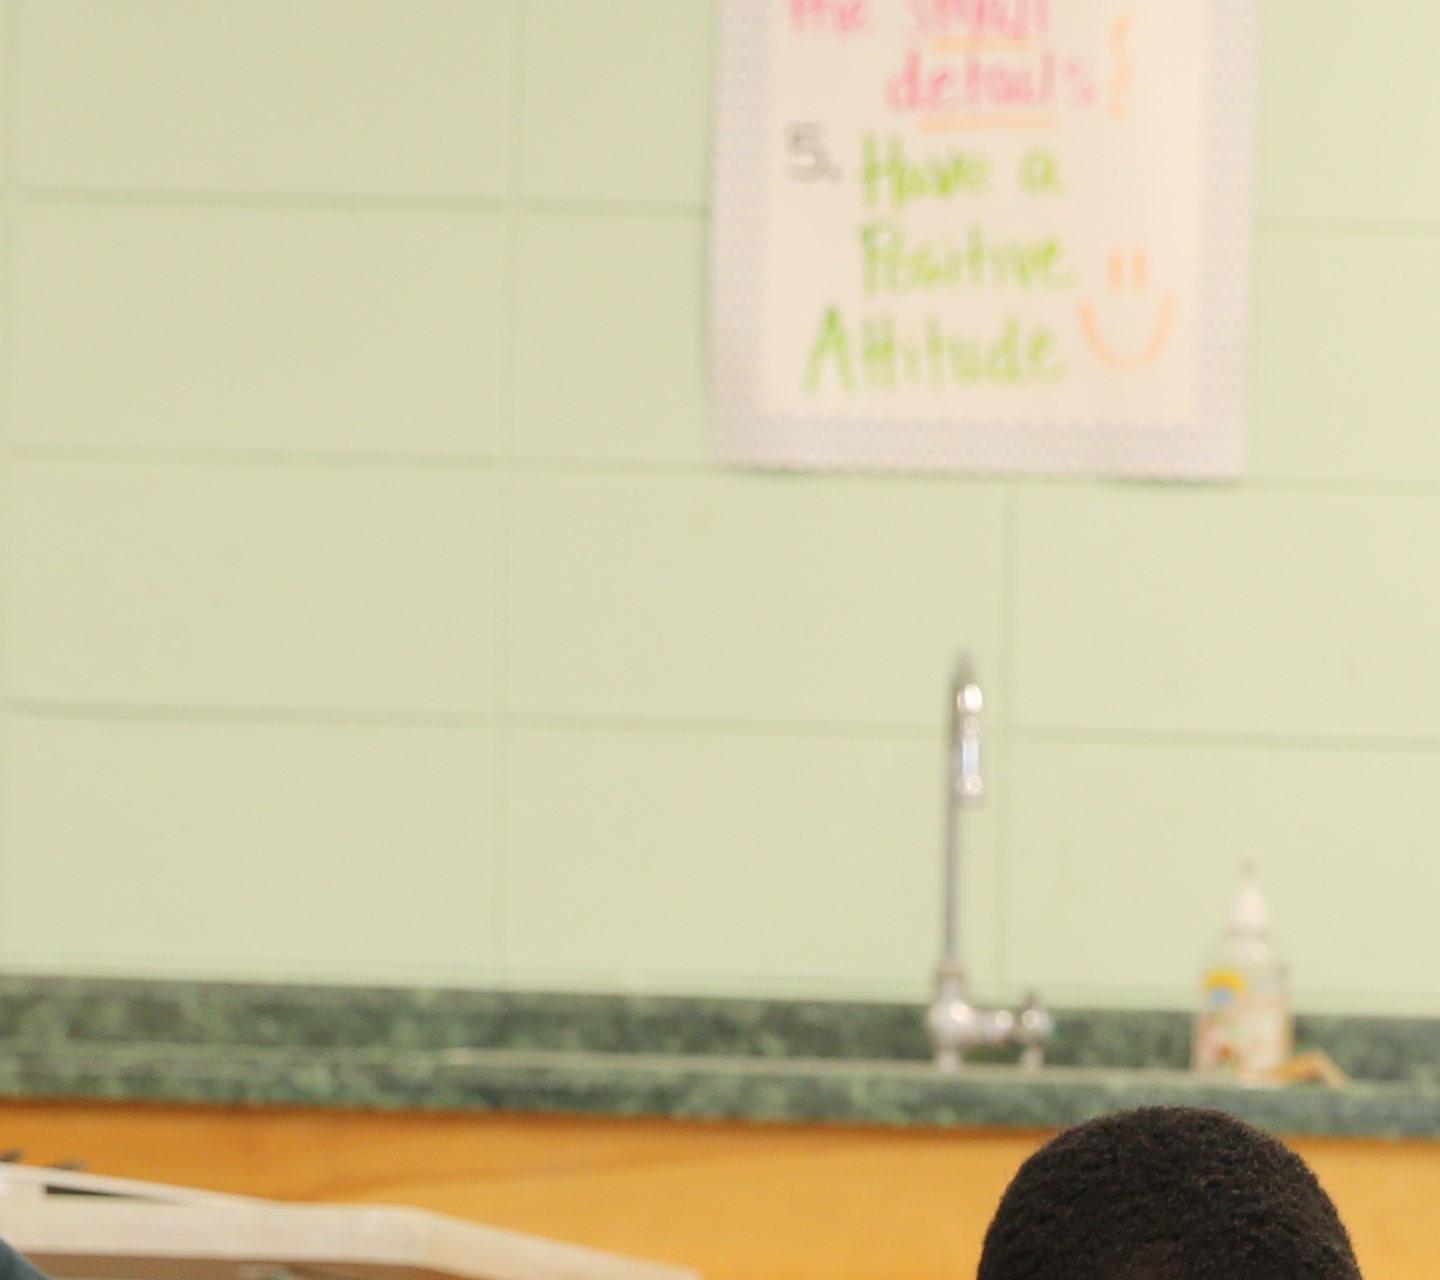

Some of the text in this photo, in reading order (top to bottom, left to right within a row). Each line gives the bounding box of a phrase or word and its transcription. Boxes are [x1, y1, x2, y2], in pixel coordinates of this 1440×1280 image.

[784, 122, 1066, 208] 5. Have a
[858, 221, 1079, 294] Positive
[802, 302, 1066, 396] Attitude
